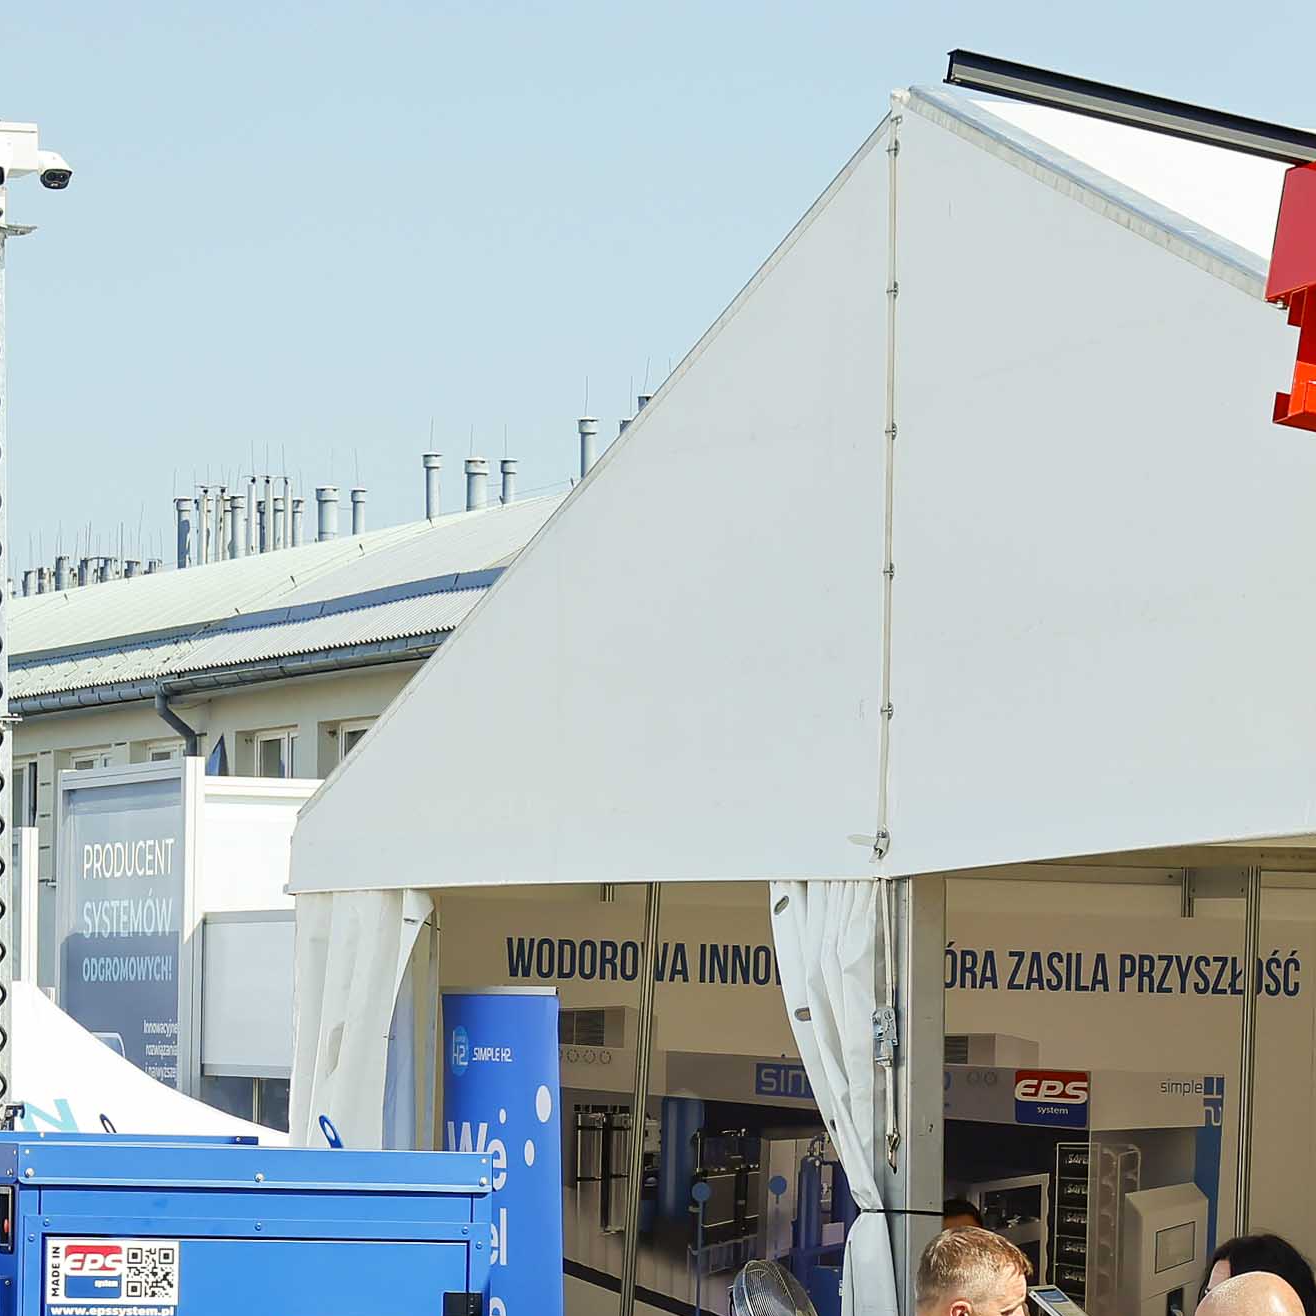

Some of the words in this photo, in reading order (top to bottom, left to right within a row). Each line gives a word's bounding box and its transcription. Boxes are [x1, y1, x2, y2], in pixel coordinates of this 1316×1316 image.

[83, 838, 175, 880] PRODUCENT
[83, 888, 172, 939] SYSTEMÓW
[82, 955, 172, 983] ODGROMOWYCH!
[699, 944, 781, 986] INNO
[944, 941, 999, 990] ÓRA
[1007, 950, 1110, 993] ZASILA
[472, 1047, 500, 1062] SIMPLE
[501, 1047, 513, 1063] H2
[1015, 1079, 1088, 1104] EPS
[1160, 1078, 1204, 1097] simple
[1037, 1105, 1068, 1115] system
[52, 1246, 60, 1258] IN
[64, 1253, 123, 1276] EPS
[51, 1264, 60, 1297] MADE
